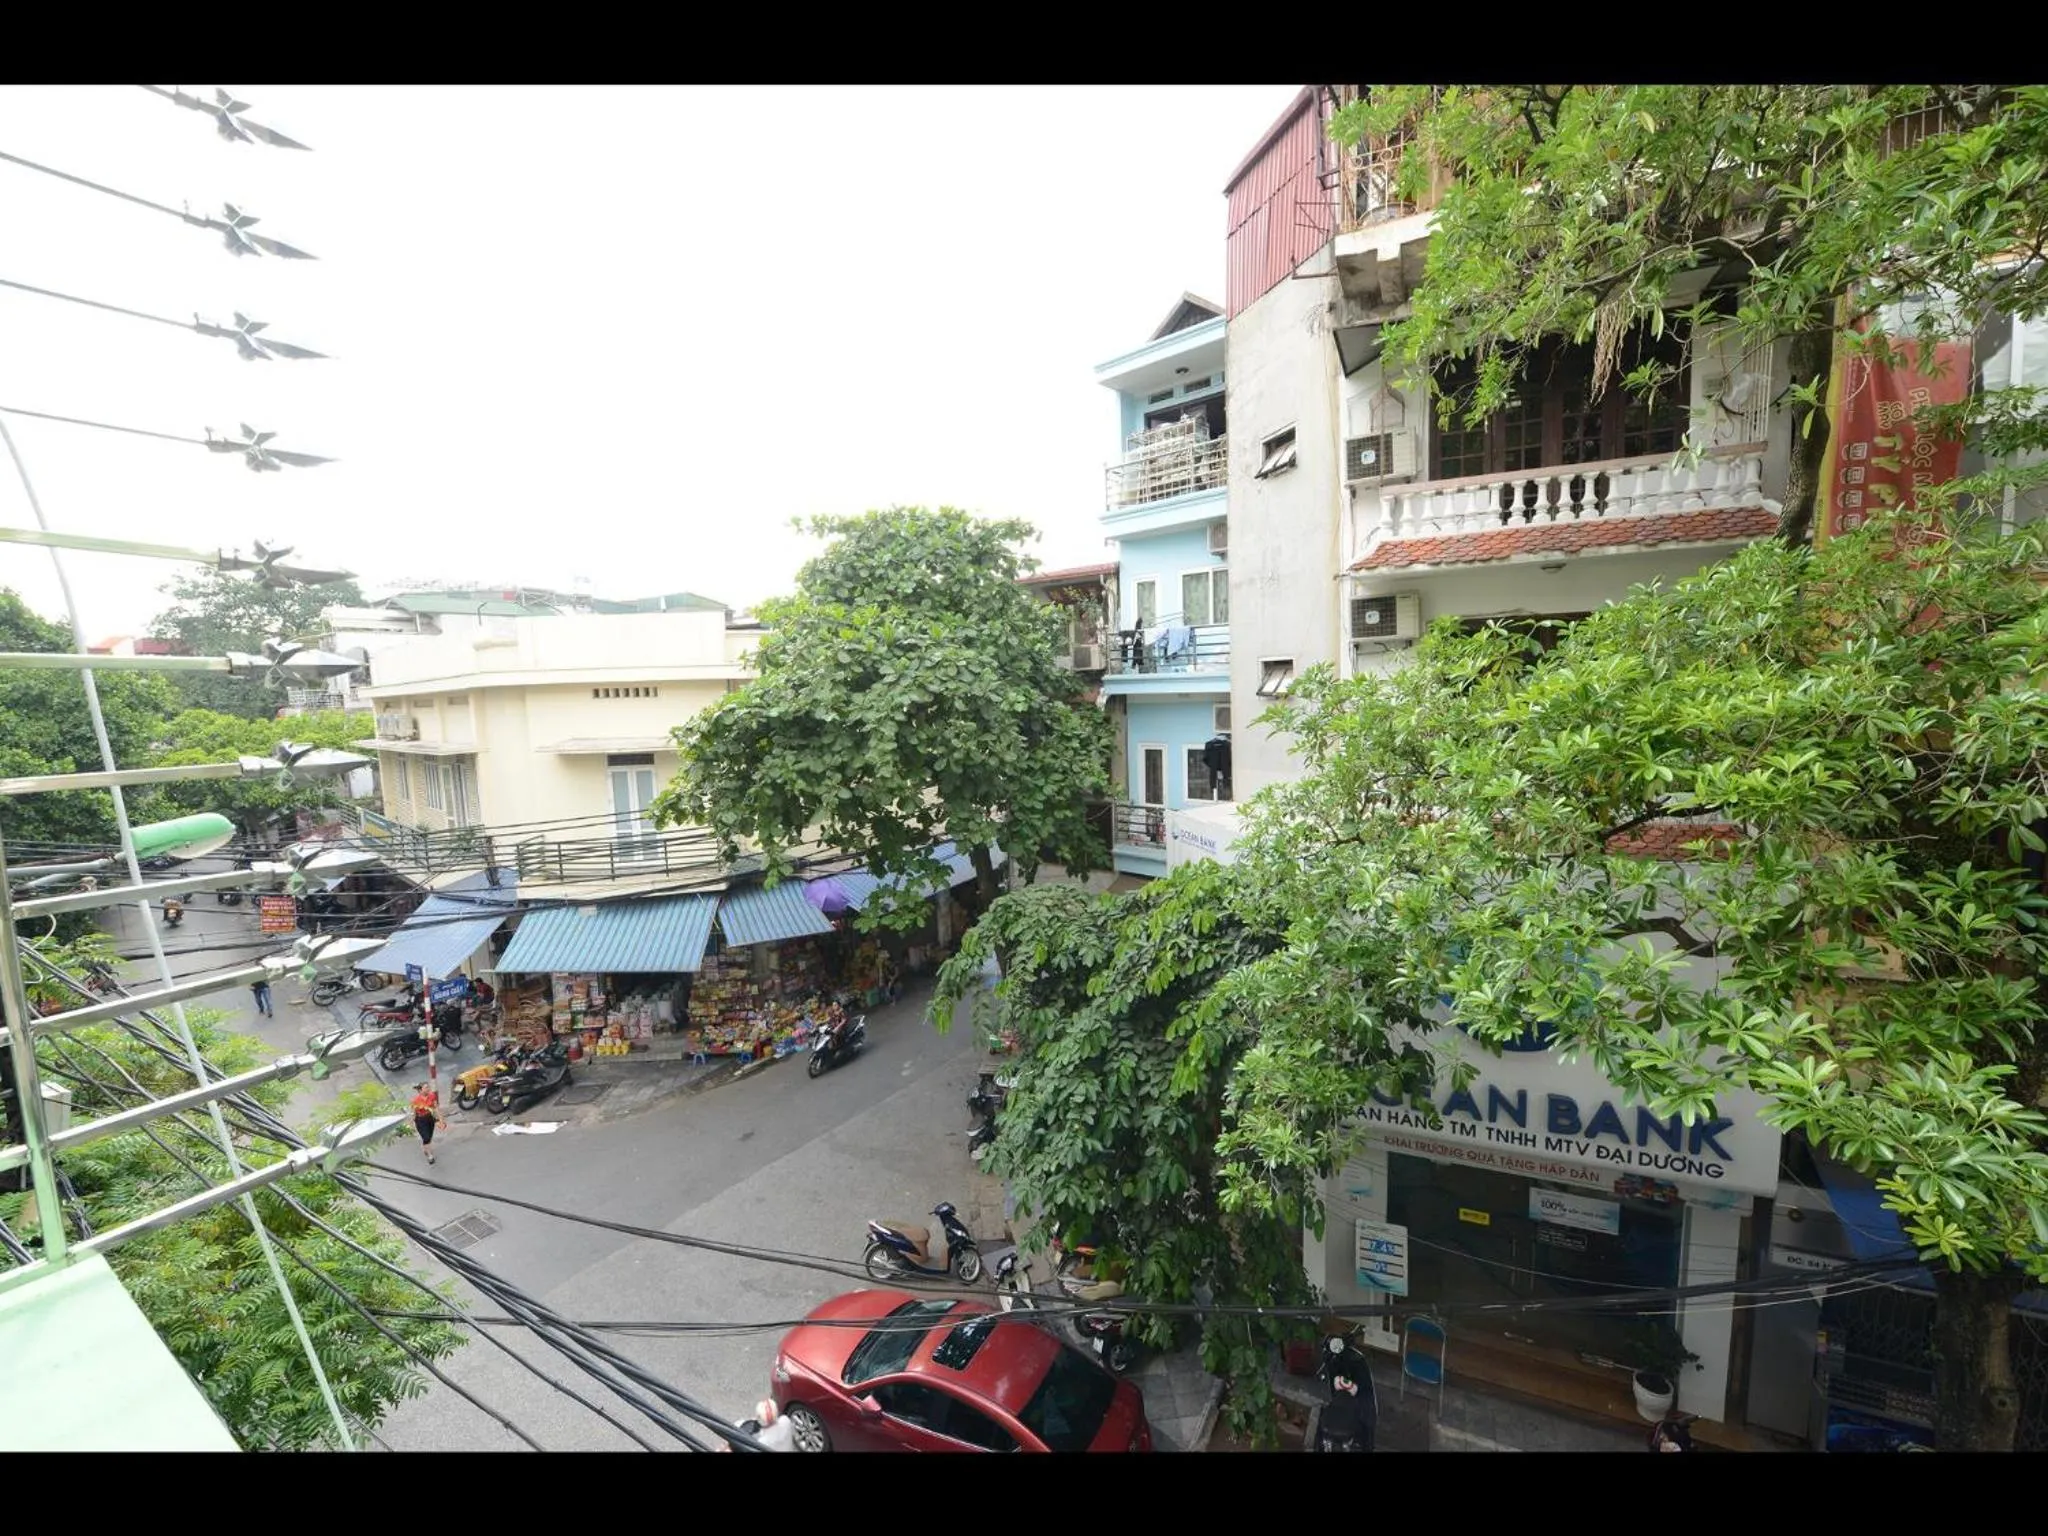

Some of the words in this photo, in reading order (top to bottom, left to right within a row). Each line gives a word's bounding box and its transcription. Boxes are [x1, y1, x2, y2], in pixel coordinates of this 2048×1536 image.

[1450, 1120, 1477, 1138] TM
[1486, 1126, 1537, 1149] TNHH
[1545, 1137, 1590, 1156] MTV
[1596, 1145, 1632, 1165] ĐẠI
[1547, 1093, 1735, 1162] BANK
